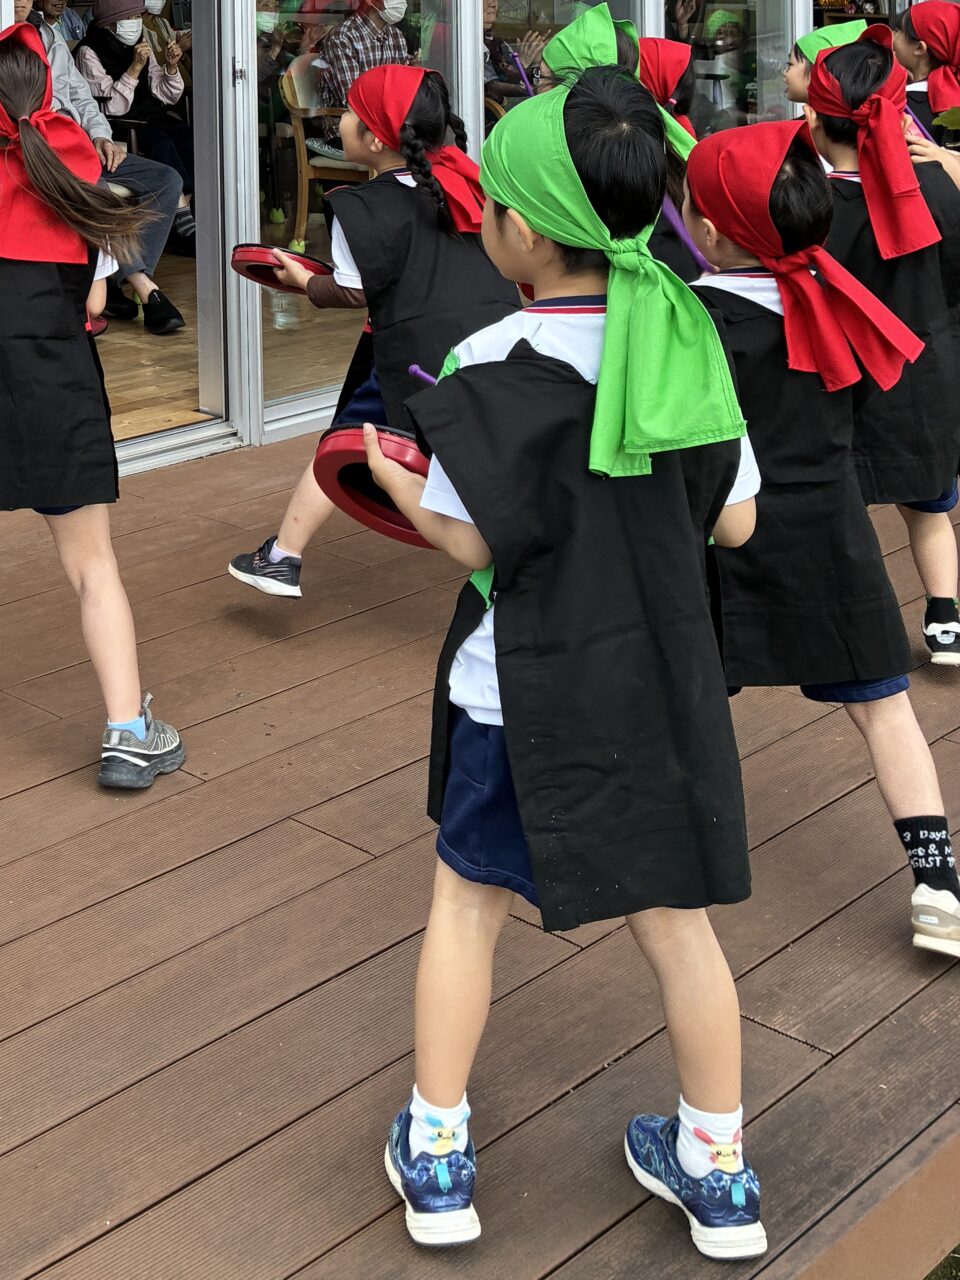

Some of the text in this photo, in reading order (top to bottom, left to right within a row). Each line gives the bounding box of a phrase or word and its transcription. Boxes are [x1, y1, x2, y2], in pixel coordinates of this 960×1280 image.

[903, 830, 947, 842] 3 Days
[927, 843, 939, 855] &
